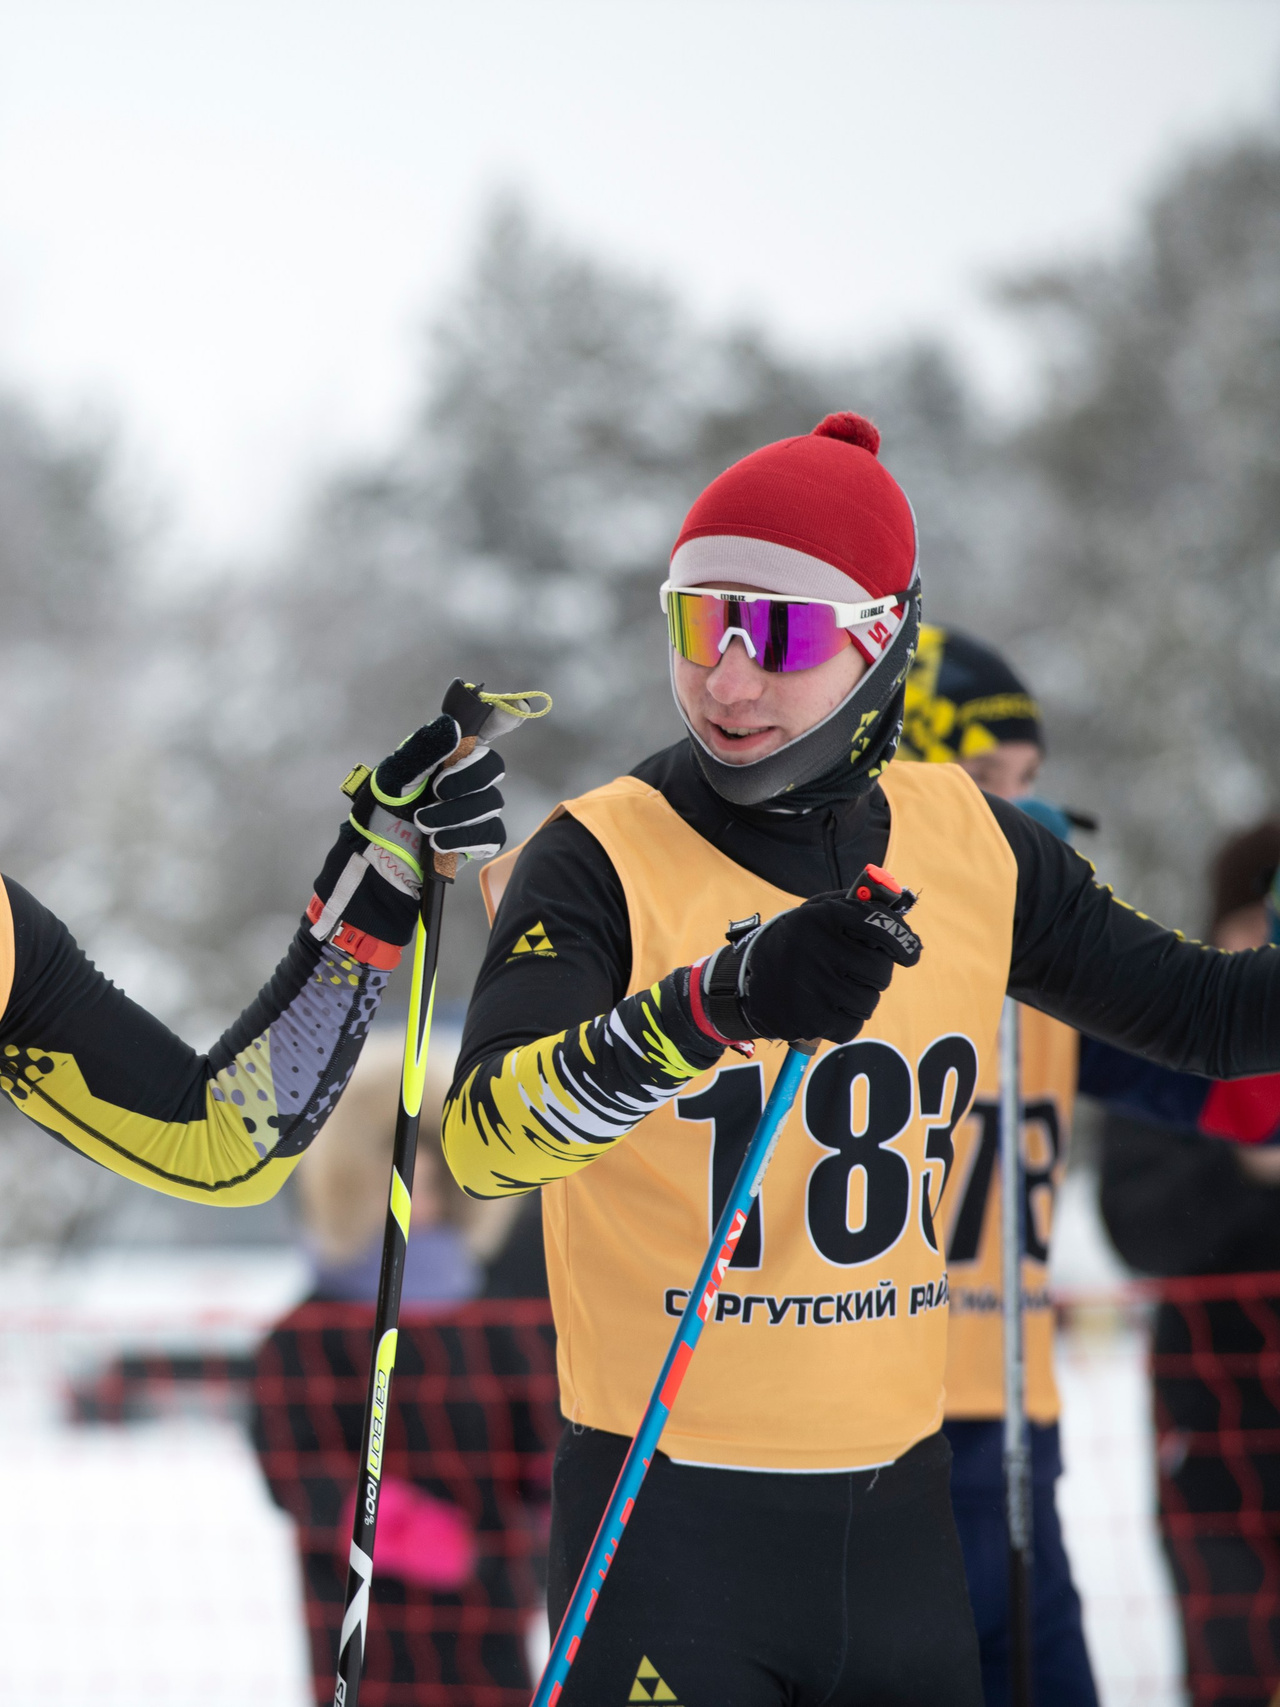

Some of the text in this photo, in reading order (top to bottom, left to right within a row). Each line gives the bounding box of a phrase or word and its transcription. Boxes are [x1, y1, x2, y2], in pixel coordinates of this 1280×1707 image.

[674, 1031, 978, 1271] 183
[664, 1281, 896, 1327] СРГУТСКИЙ
[364, 1476, 378, 1526] 100%
